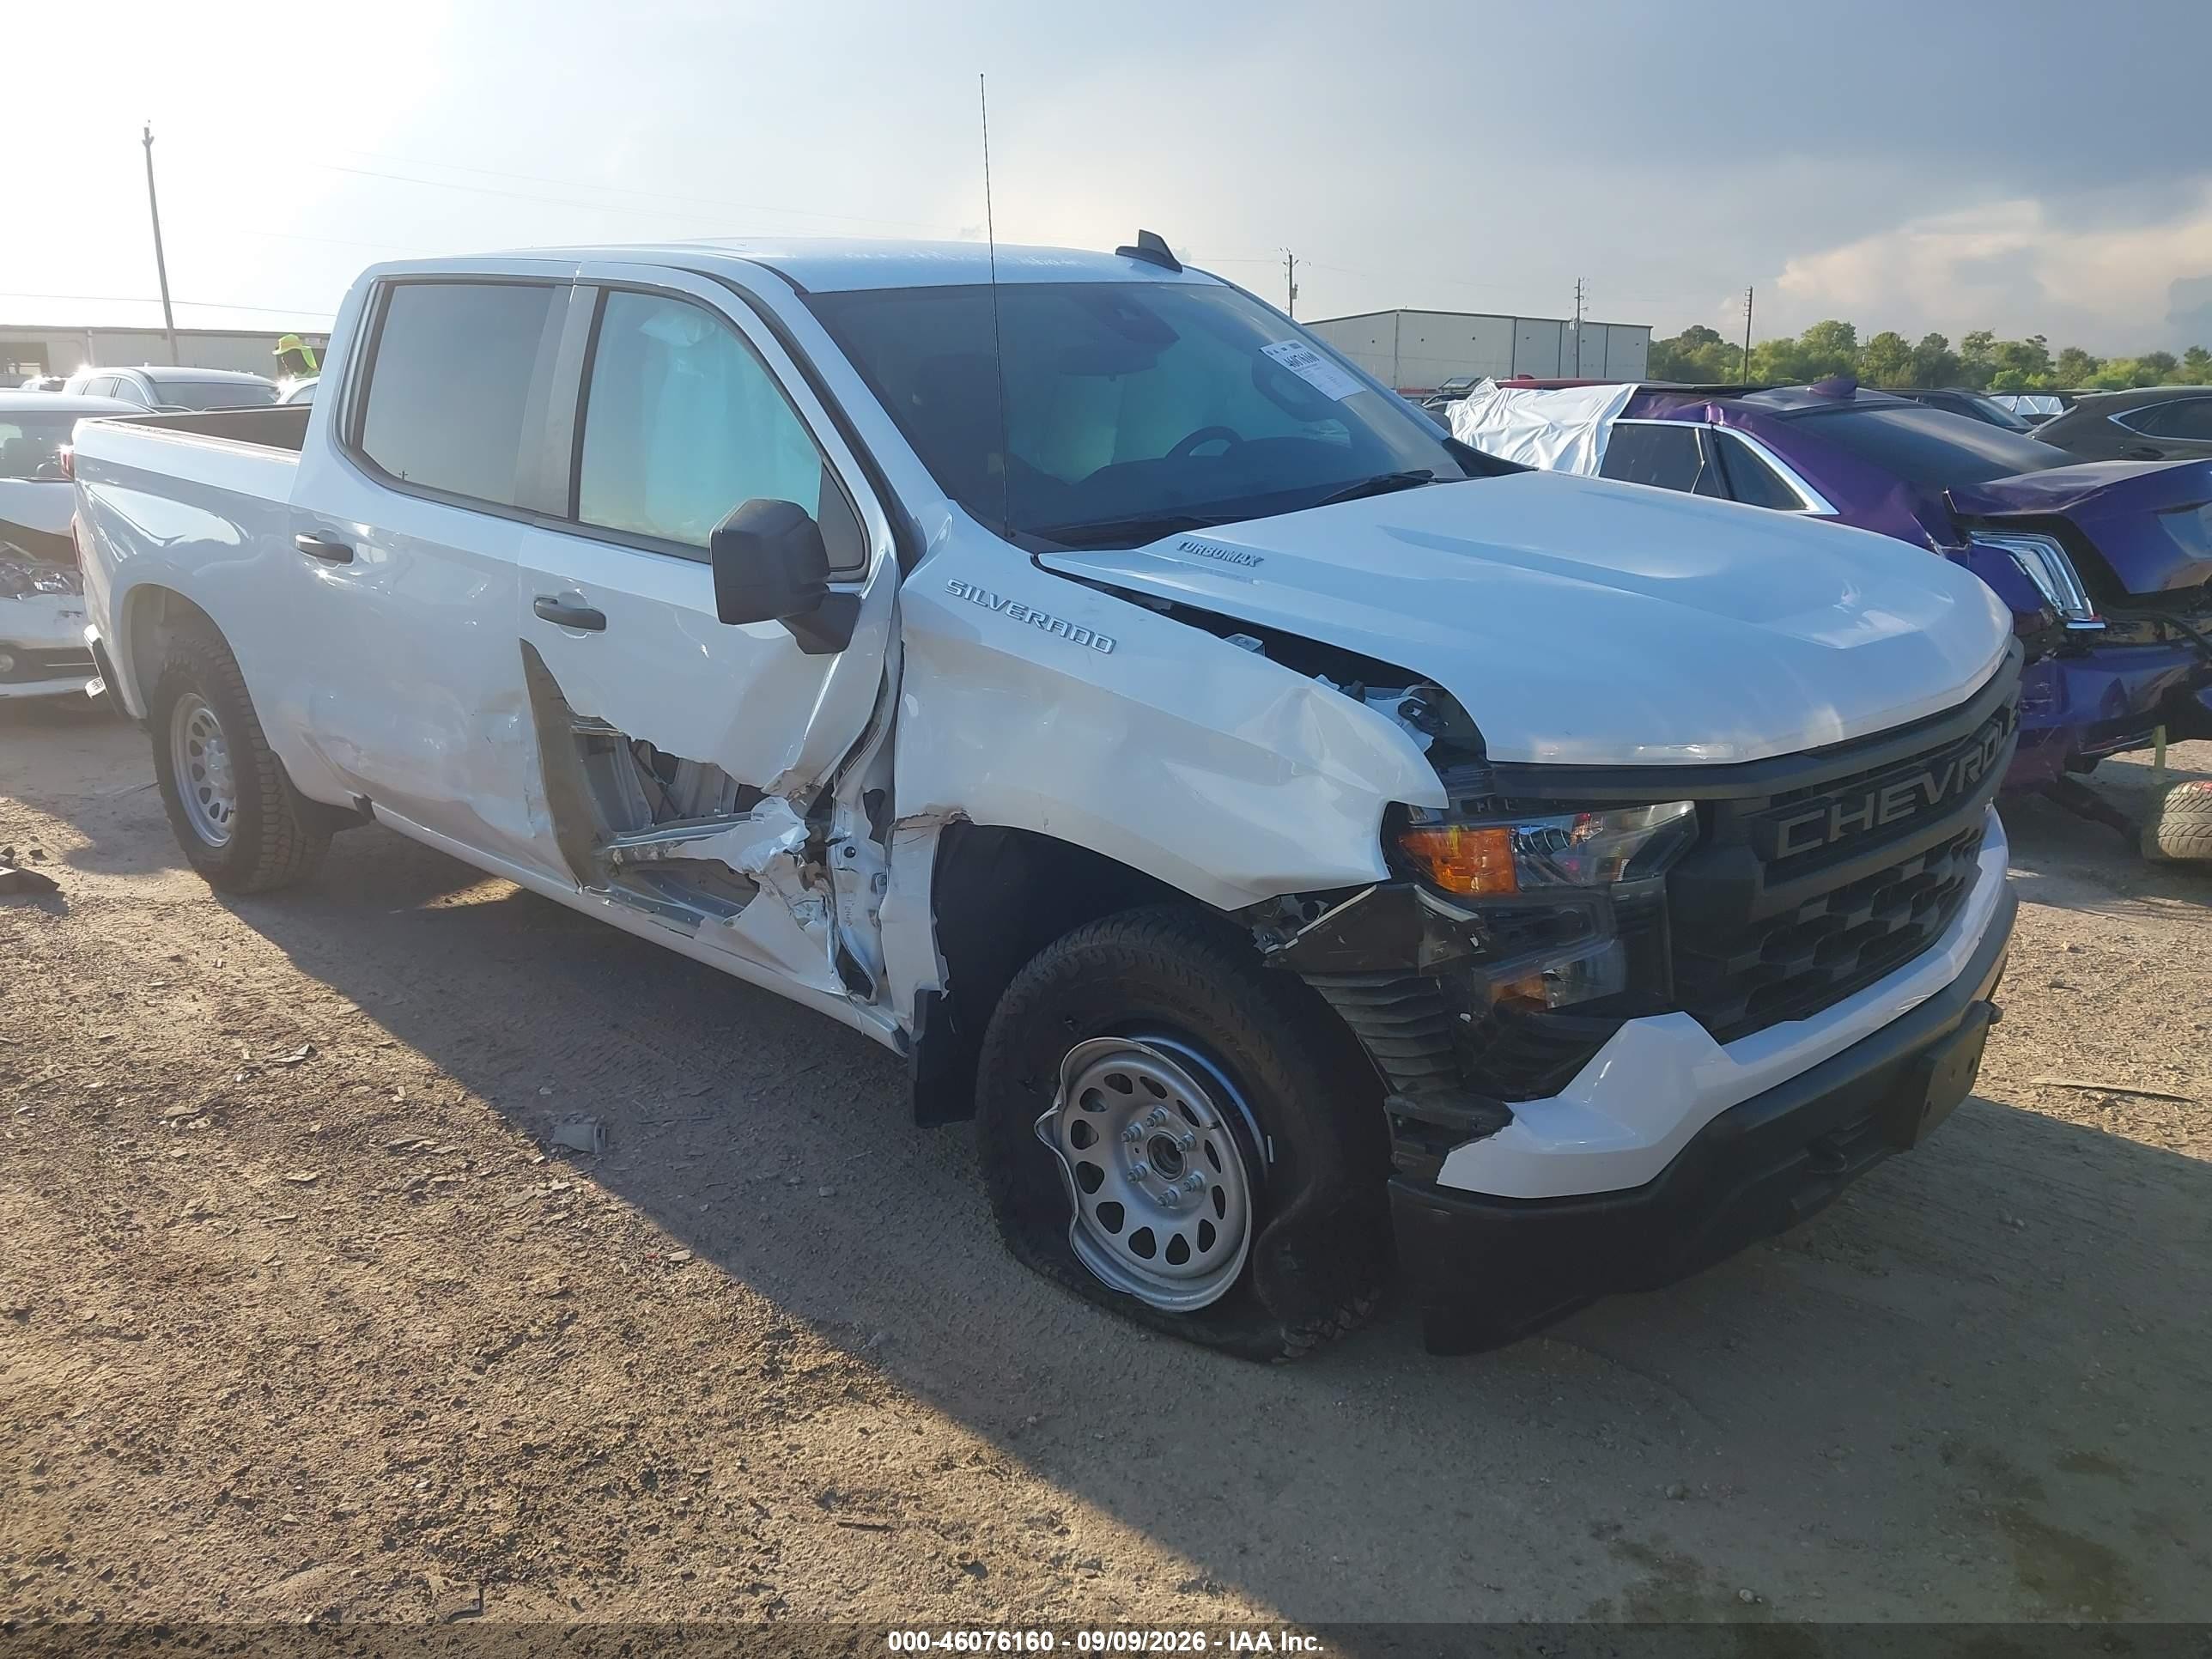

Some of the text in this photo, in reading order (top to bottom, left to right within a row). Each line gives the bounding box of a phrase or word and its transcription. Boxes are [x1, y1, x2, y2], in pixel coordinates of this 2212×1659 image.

[1176, 538, 1265, 568] TURBOMAX
[945, 578, 1117, 654] SILVERADO
[1776, 704, 2019, 860] CHEVROLE
